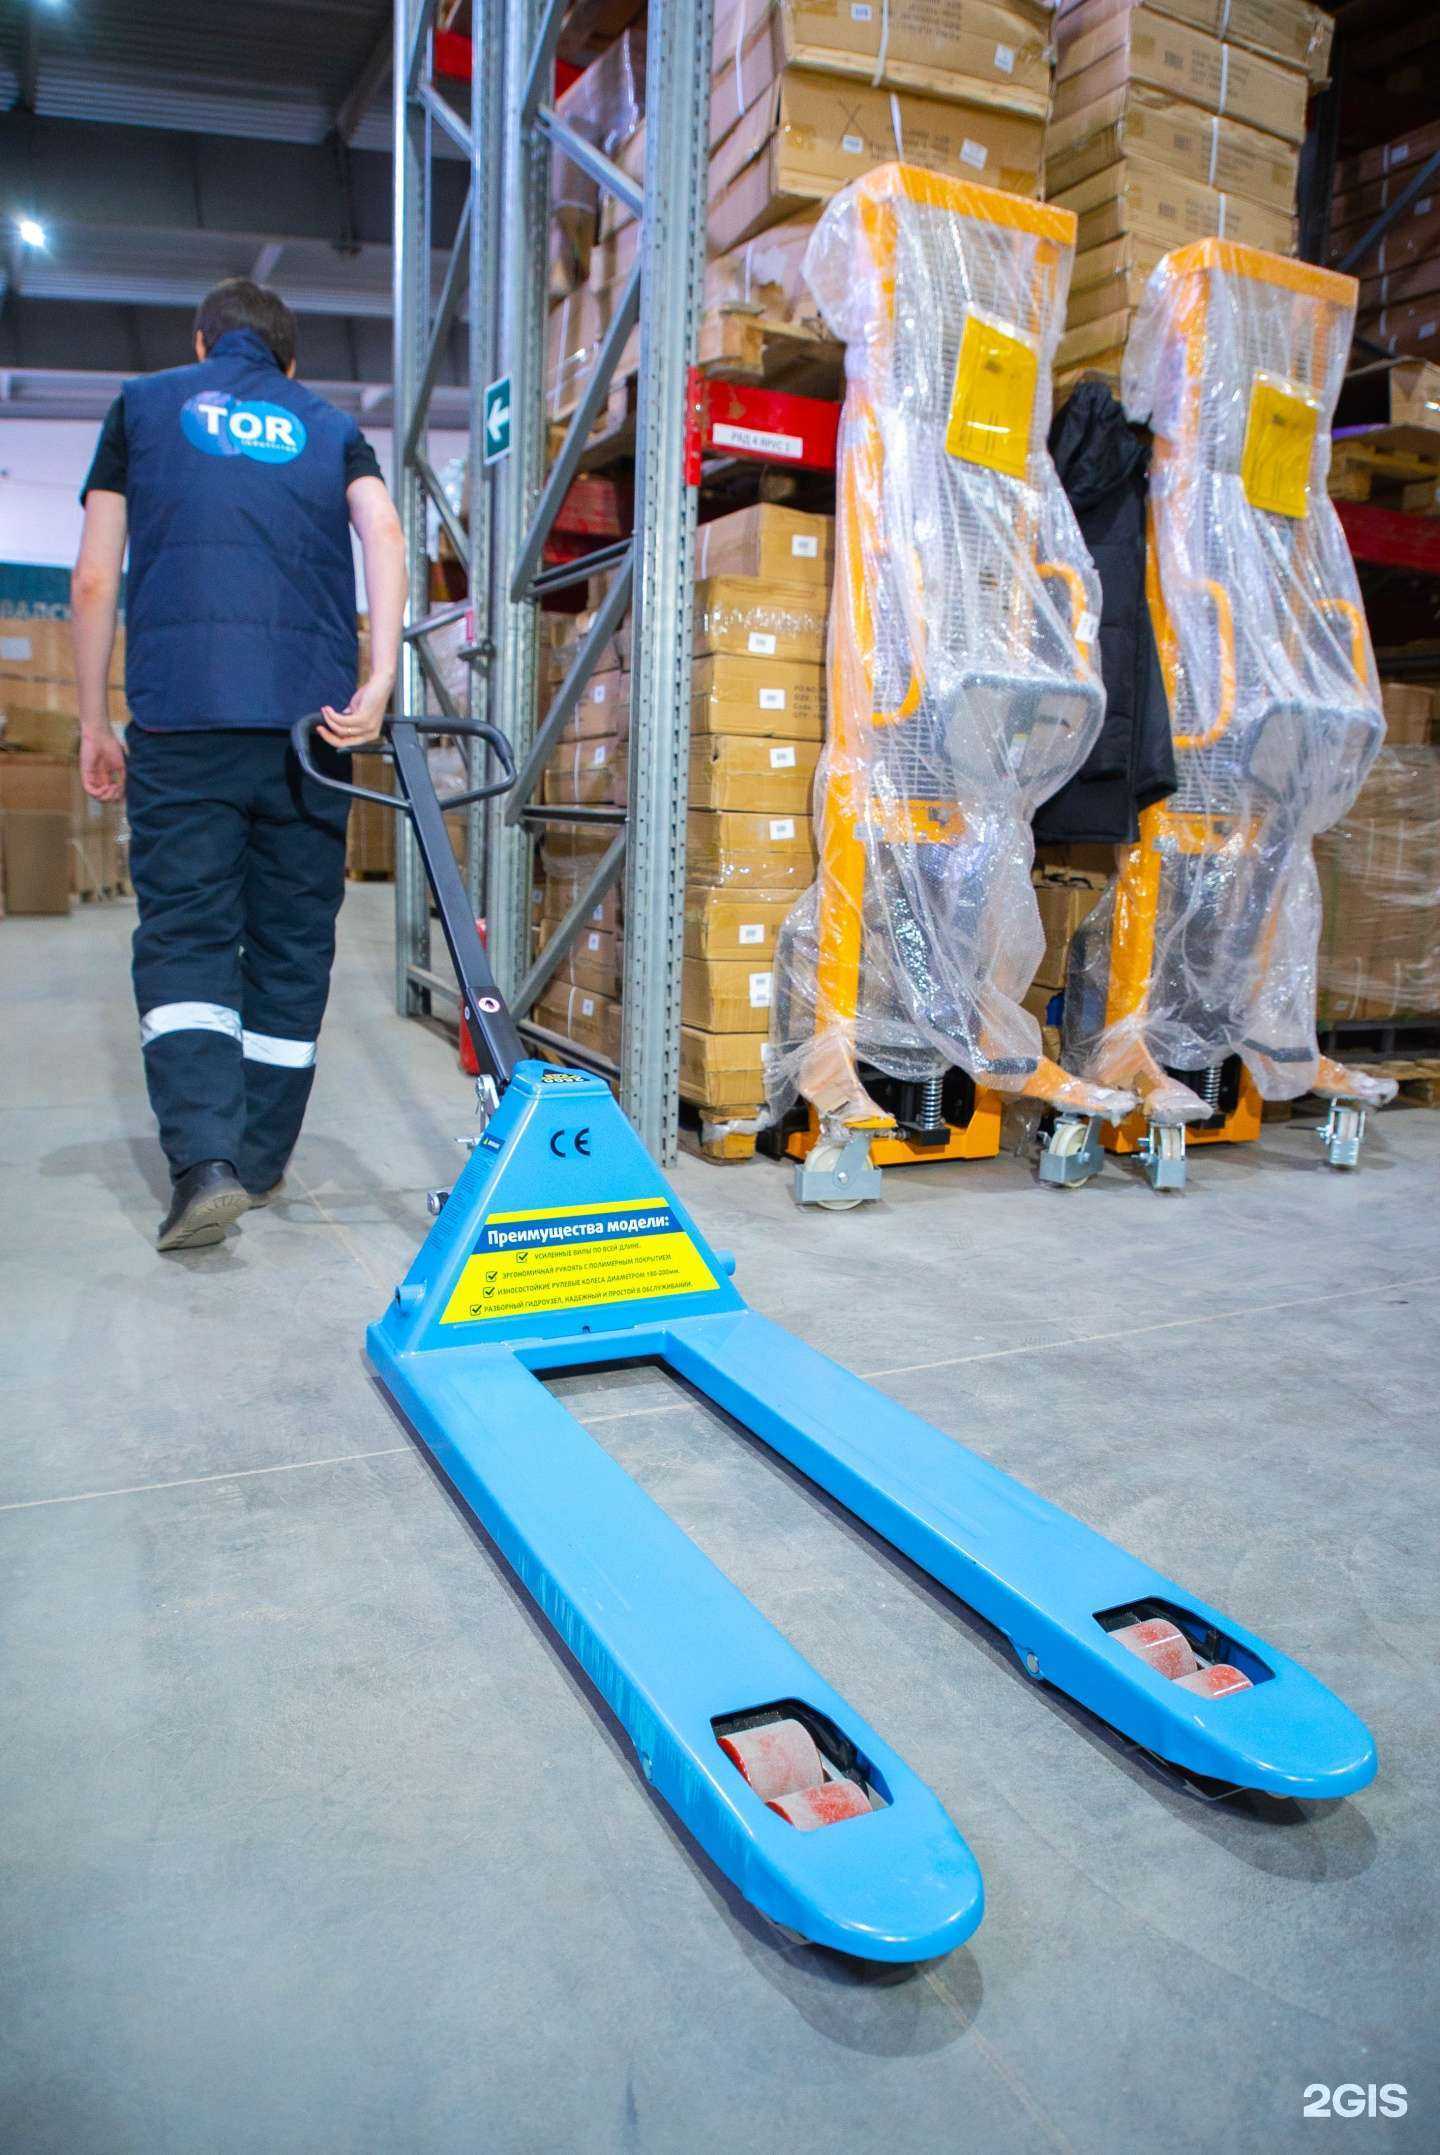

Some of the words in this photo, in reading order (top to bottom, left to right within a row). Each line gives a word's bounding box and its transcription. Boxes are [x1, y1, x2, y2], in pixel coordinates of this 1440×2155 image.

[198, 403, 297, 447] TOR
[550, 1128, 591, 1158] CE
[488, 1222, 604, 1247] Преимущества
[607, 1216, 670, 1232] модели:
[502, 1267, 554, 1279] ЭРГОНОМИЧНАЯ
[555, 1264, 583, 1273] РУКОЯТЬ
[588, 1258, 633, 1270] ПОЛИМЕРНЫМ
[497, 1283, 551, 1295] ИЗНОСОСТОЙКИЕ
[551, 1279, 580, 1288] РУЛЕВЫЕ
[581, 1276, 606, 1285] КОЛЕСА
[483, 1300, 525, 1313] РАЗБОРНЫЙ
